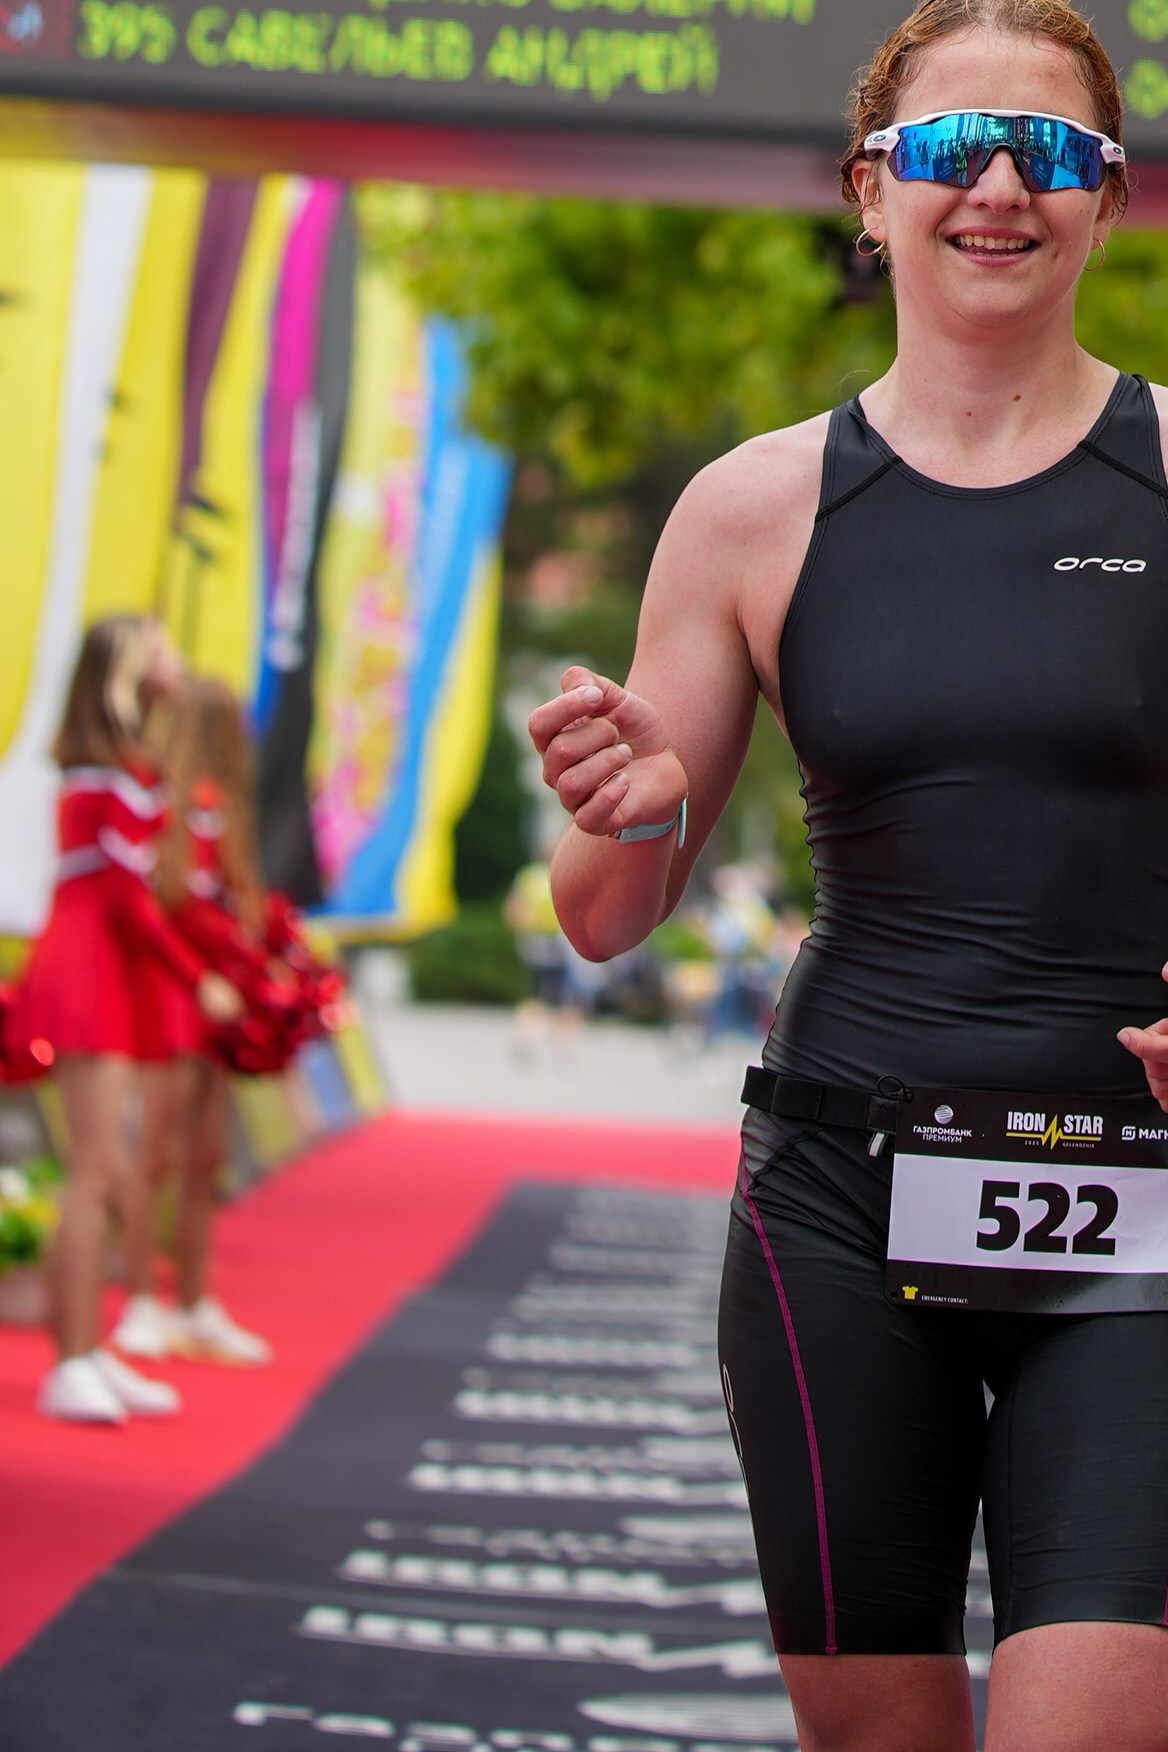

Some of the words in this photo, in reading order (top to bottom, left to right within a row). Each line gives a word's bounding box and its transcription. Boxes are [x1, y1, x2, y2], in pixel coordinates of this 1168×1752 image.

[1054, 557, 1147, 573] orca
[913, 1125, 972, 1137] ГАЗПРОМБАНК
[1007, 1111, 1046, 1132] IRON
[1063, 1114, 1104, 1135] STAR
[922, 1133, 962, 1143] ПРЕМИУМ
[976, 1179, 1119, 1256] 522
